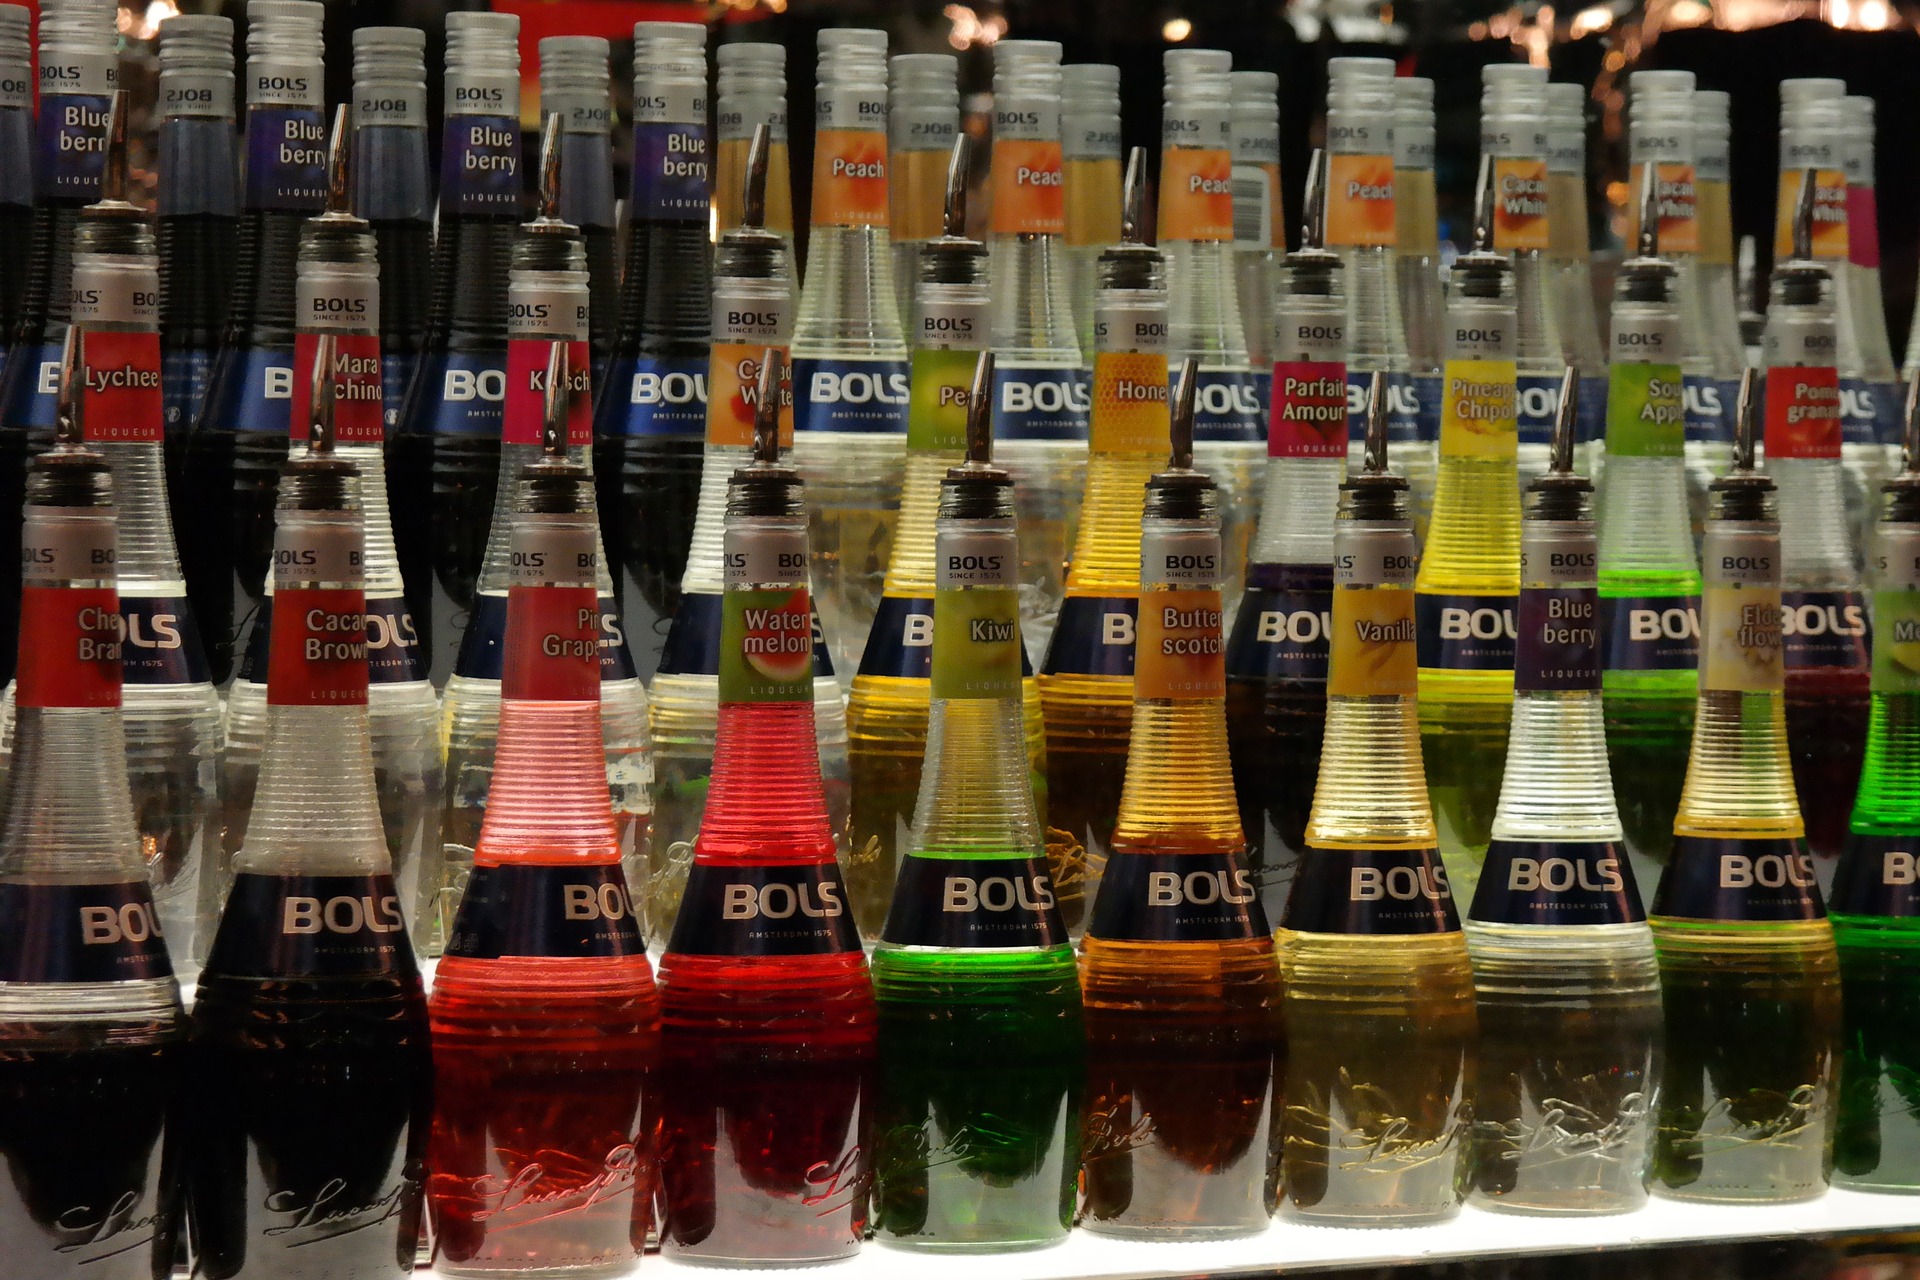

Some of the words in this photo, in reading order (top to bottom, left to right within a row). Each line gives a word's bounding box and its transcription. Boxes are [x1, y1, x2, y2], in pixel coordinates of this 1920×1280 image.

[258, 77, 308, 90] BOLS
[456, 88, 503, 100] BOLS
[637, 97, 667, 109] OLS
[65, 106, 109, 126] Blue
[859, 101, 886, 114] BOL
[285, 120, 324, 140] Blue
[471, 126, 513, 146] Blue
[60, 131, 105, 152] berr
[668, 133, 706, 153] Blue
[280, 144, 327, 170] berry
[465, 150, 516, 176] berry
[663, 157, 708, 181] berry
[833, 158, 884, 178] Peach
[57, 176, 99, 185] LIQUE
[1190, 175, 1231, 193] Peac
[463, 193, 516, 202] LIQUEUR
[72, 290, 99, 303] OLS
[313, 298, 366, 312] BOLS
[728, 312, 777, 326] BOLS
[924, 317, 973, 331] BOLS
[1298, 326, 1342, 339] BOLS
[1456, 329, 1502, 342] BOLS
[1618, 333, 1662, 345] BOLS
[335, 353, 378, 374] Mara
[738, 360, 792, 380] Caao
[86, 366, 158, 392] Lychee
[444, 369, 507, 401] BO
[530, 371, 590, 391] Ksch
[631, 372, 708, 404] BOL
[810, 372, 911, 405] BOLS
[1285, 378, 1345, 397] Parfait
[335, 379, 382, 400] chino
[741, 386, 792, 405] Wte
[1002, 381, 1091, 413] BOLS
[1346, 383, 1421, 415] BLS
[1283, 403, 1345, 420] Amour
[94, 428, 155, 436] LIQUEUR
[934, 437, 966, 445] LIQU
[24, 548, 55, 563] OLS
[512, 553, 544, 567] OLS
[724, 554, 747, 567] OLS
[778, 554, 807, 568] BOL
[949, 556, 1001, 570] BOLS
[1166, 555, 1215, 569] BOLS
[1383, 556, 1412, 569] BOL
[1551, 553, 1595, 567] BOLS
[1722, 557, 1770, 570] BOLS
[1164, 607, 1222, 629] Butter
[1549, 598, 1592, 618] Blue
[79, 607, 120, 630] Che
[745, 609, 807, 631] Water
[1782, 604, 1867, 636] BOLS
[121, 614, 181, 649] LS
[366, 614, 418, 649] OLS
[971, 618, 1015, 641] Kiwi
[1543, 622, 1597, 649] berry
[744, 631, 808, 653] melon
[1163, 632, 1224, 655] scotch
[1541, 670, 1597, 678] LIQUEUR
[750, 686, 809, 694] LIQUEUR
[1507, 857, 1624, 892] BOLS
[1719, 854, 1816, 888] BOLS
[1147, 869, 1255, 906] BOLS
[1350, 866, 1450, 901] BOLS
[722, 881, 843, 920] BOLS
[942, 876, 1055, 912] BOLS
[282, 896, 401, 934] BOLS
[1529, 902, 1586, 910] AMSTERDAM
[970, 923, 1027, 931] AMSTERDAM
[1234, 915, 1249, 923] 1575
[379, 945, 396, 953] 1575
